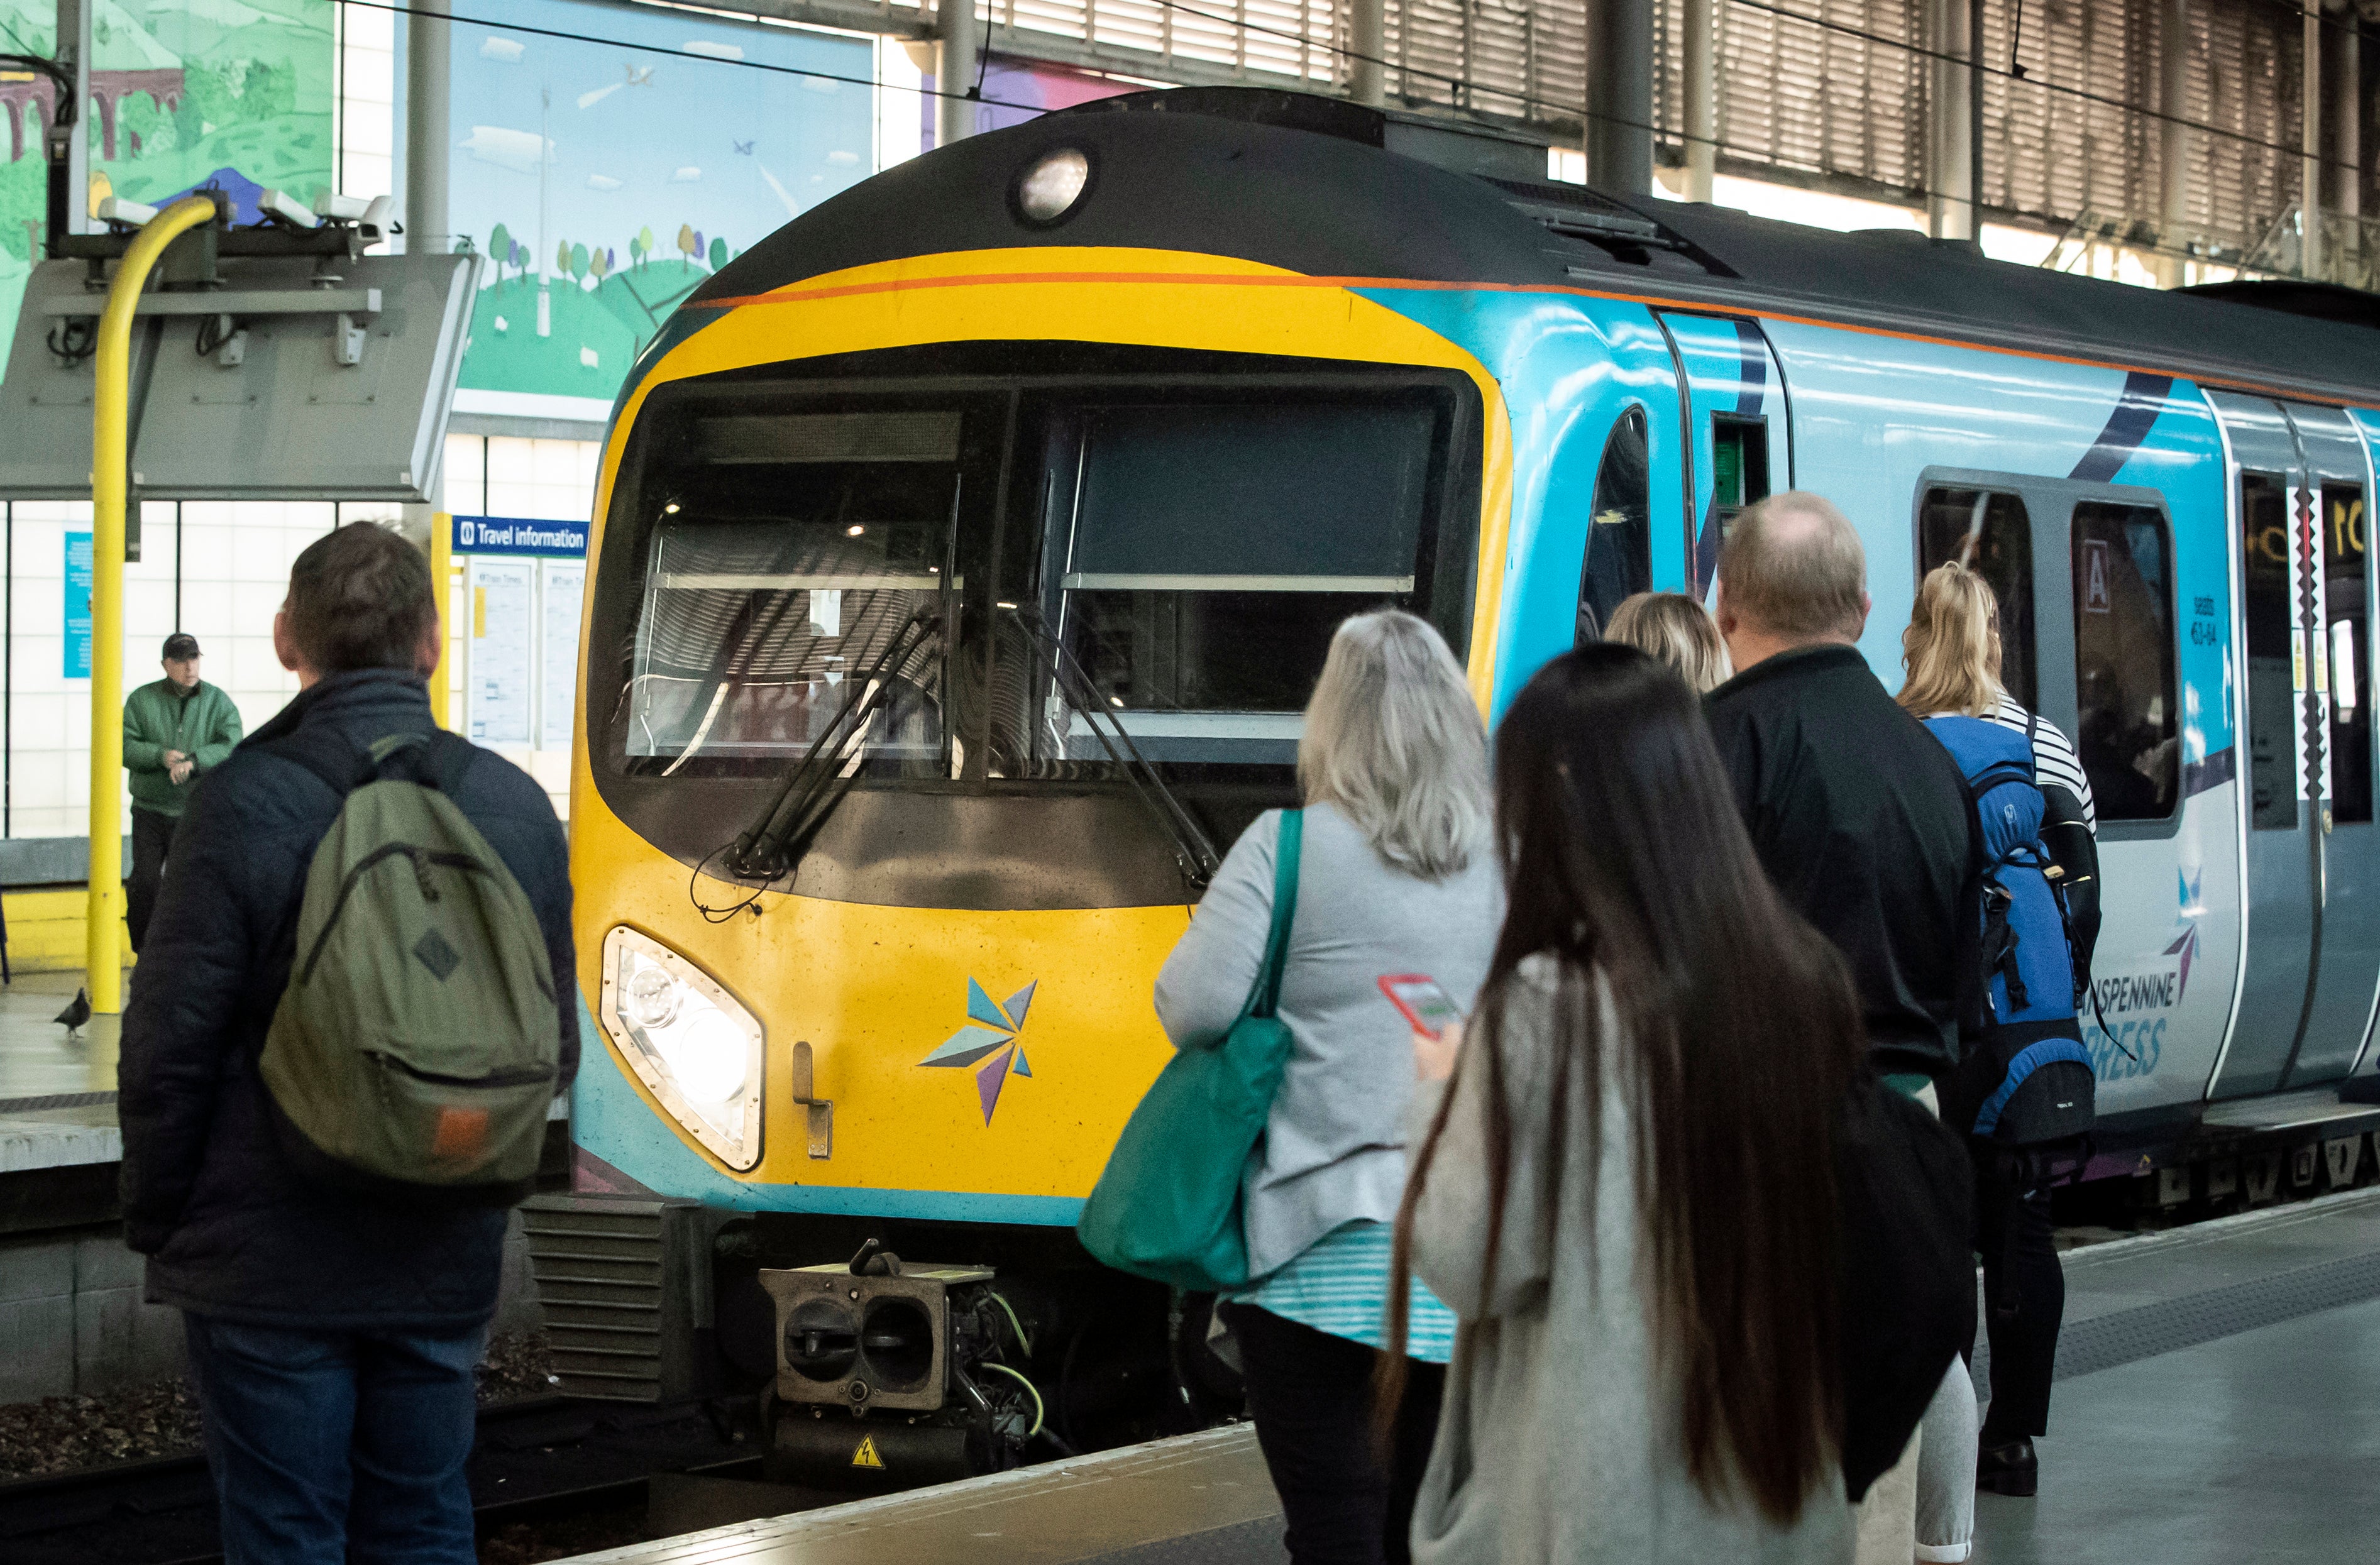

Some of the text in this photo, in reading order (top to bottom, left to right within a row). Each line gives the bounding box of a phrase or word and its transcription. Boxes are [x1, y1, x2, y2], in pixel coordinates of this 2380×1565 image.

[477, 523, 584, 548] Travel information
[2089, 549, 2107, 604] A
[2081, 972, 2177, 1016] NSPENNINE
